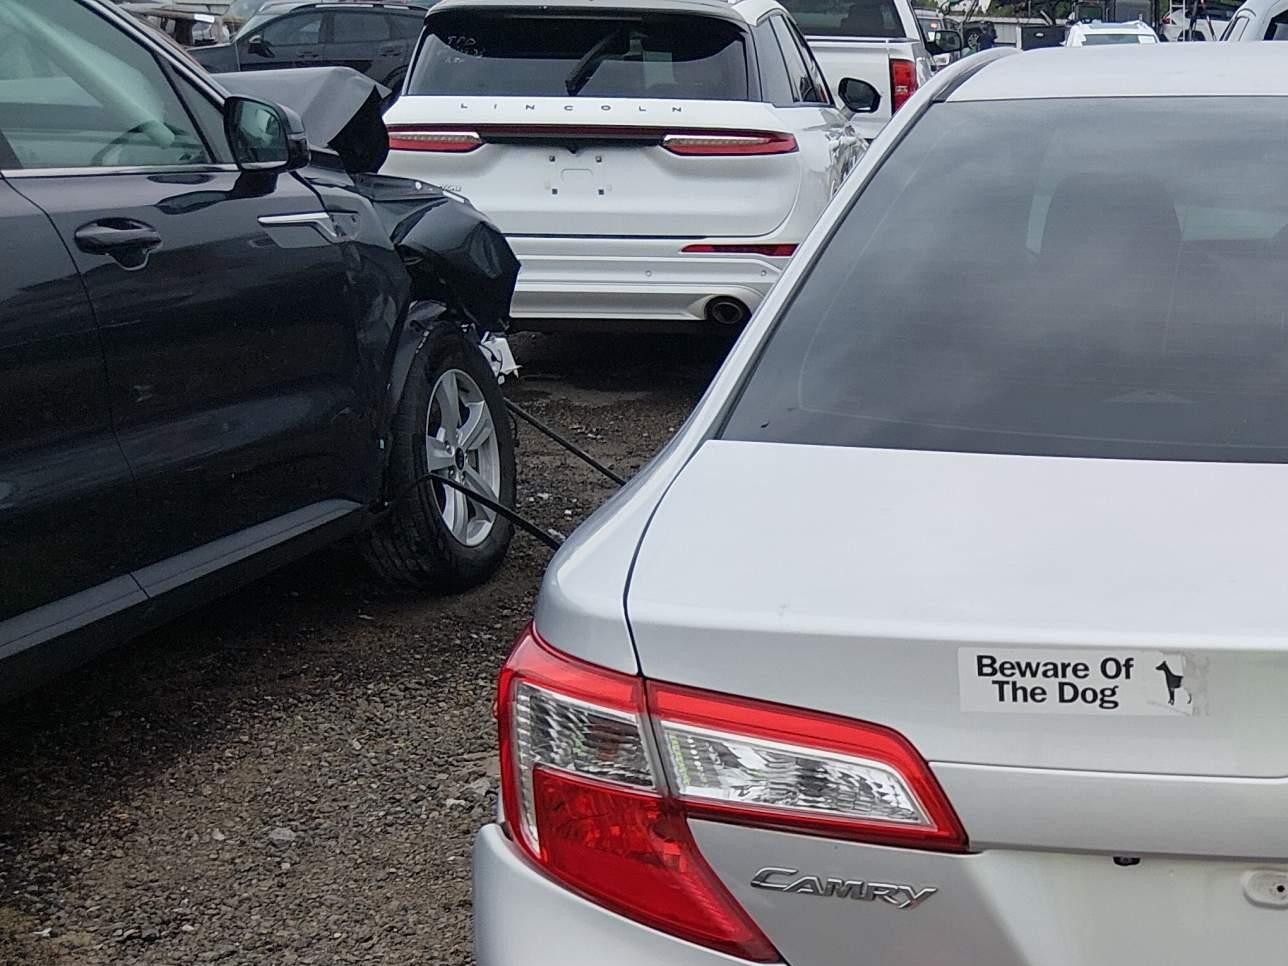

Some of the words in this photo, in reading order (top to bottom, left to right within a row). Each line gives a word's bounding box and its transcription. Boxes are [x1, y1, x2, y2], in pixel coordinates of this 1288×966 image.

[460, 103, 682, 113] LINCOLN
[976, 655, 1090, 679] Beware
[1100, 657, 1134, 680] Of
[991, 680, 1047, 702] The
[1057, 681, 1119, 710] Dog
[751, 867, 938, 909] CAMRY
